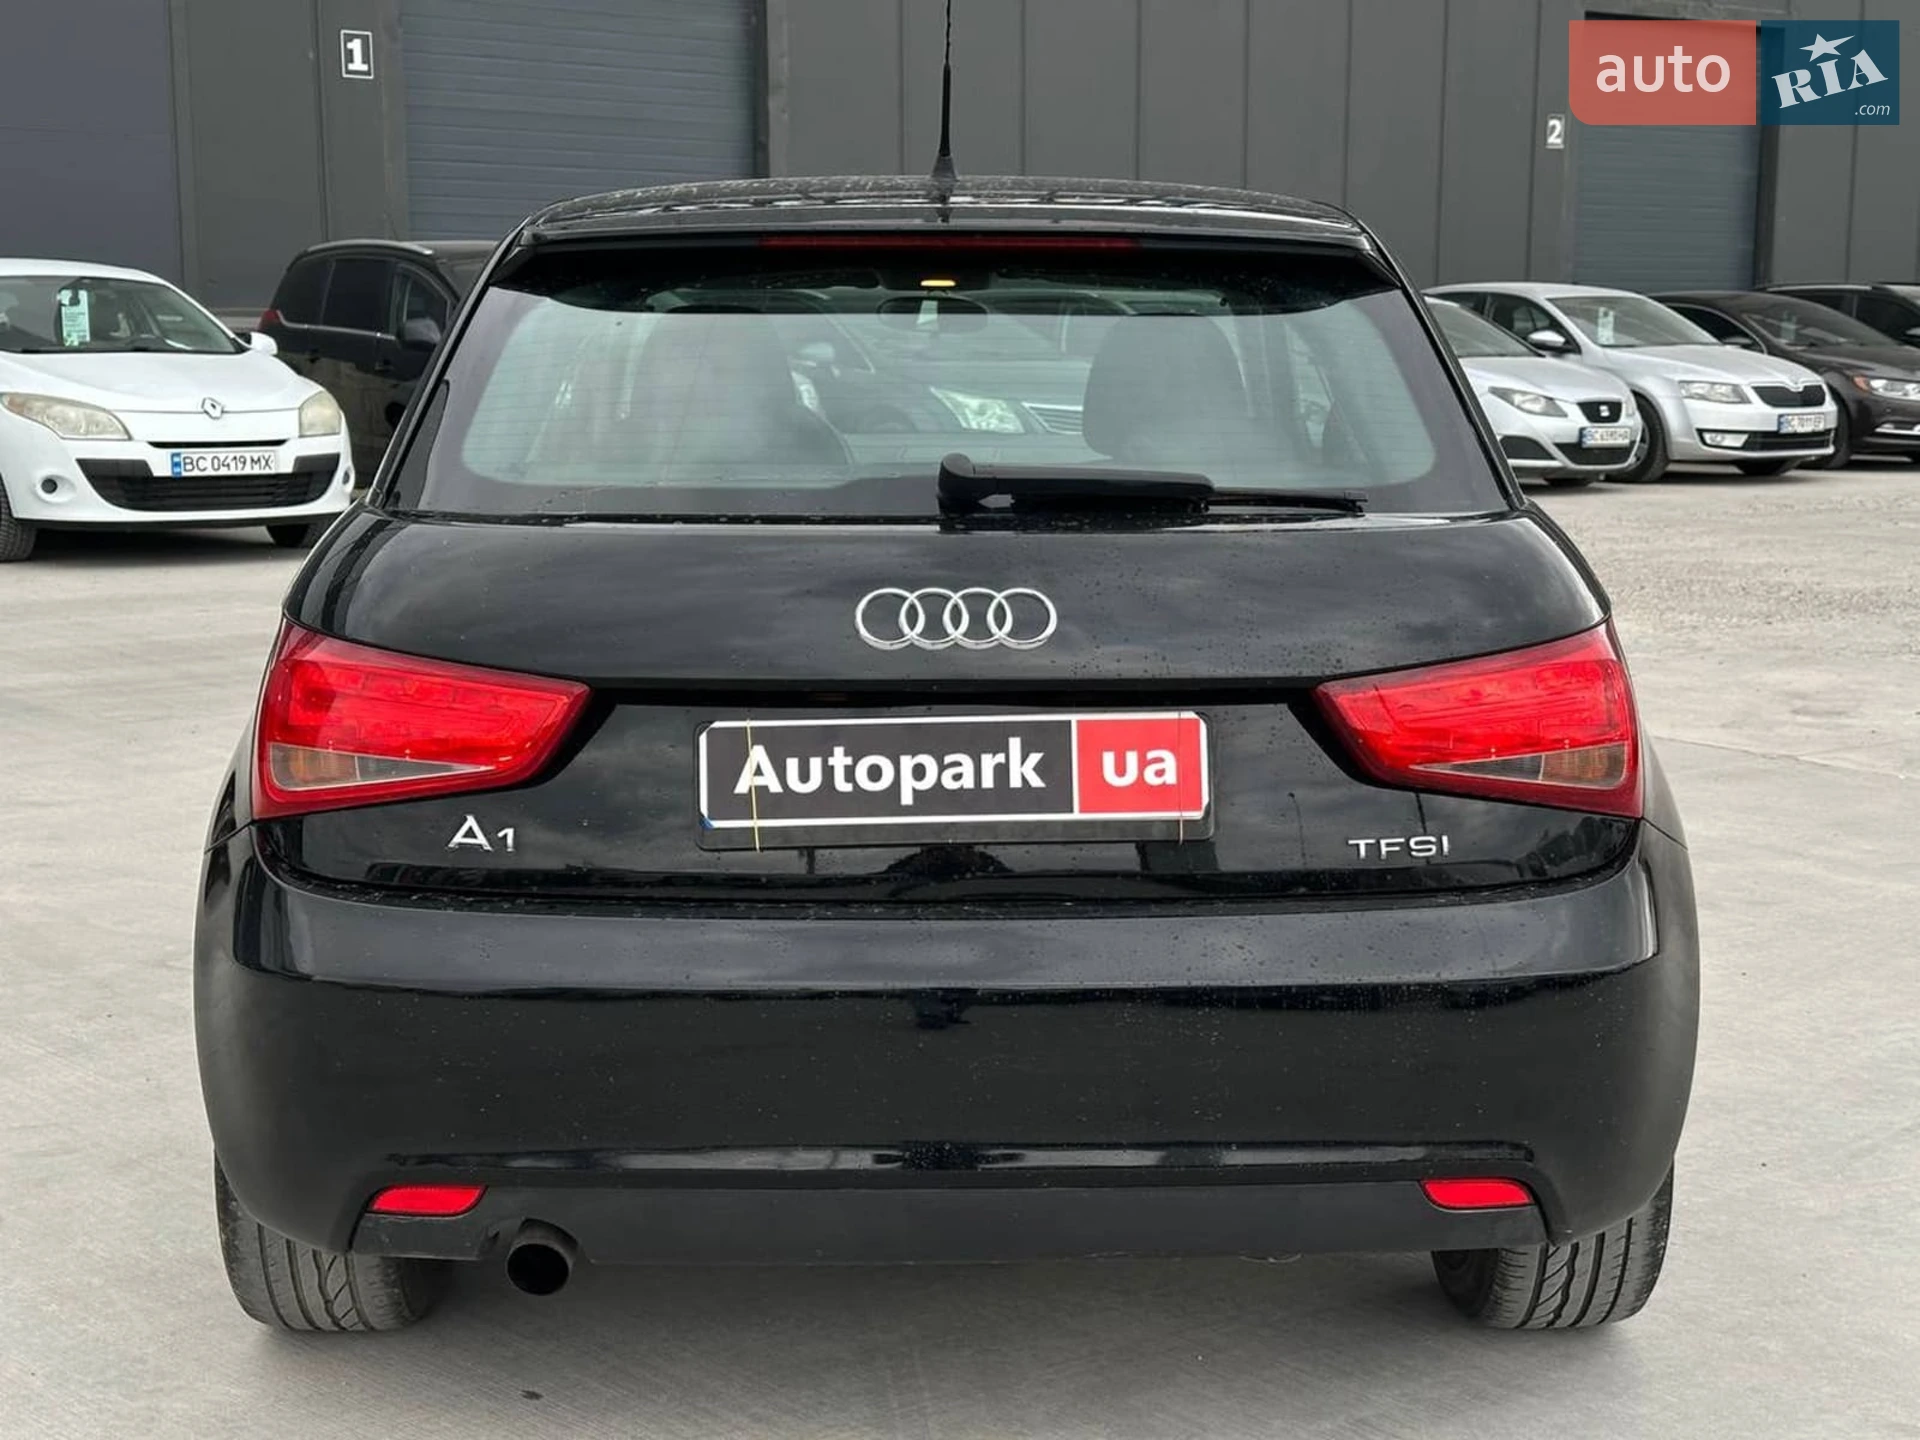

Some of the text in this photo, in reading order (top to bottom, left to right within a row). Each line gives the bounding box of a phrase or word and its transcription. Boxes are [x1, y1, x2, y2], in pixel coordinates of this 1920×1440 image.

[346, 38, 369, 72] 1
[1547, 119, 1561, 144] 2
[182, 454, 272, 473] BC 0419 MX
[733, 736, 1178, 805] Autopark ua
[447, 814, 515, 852] A1
[1347, 834, 1450, 859] TFSI
